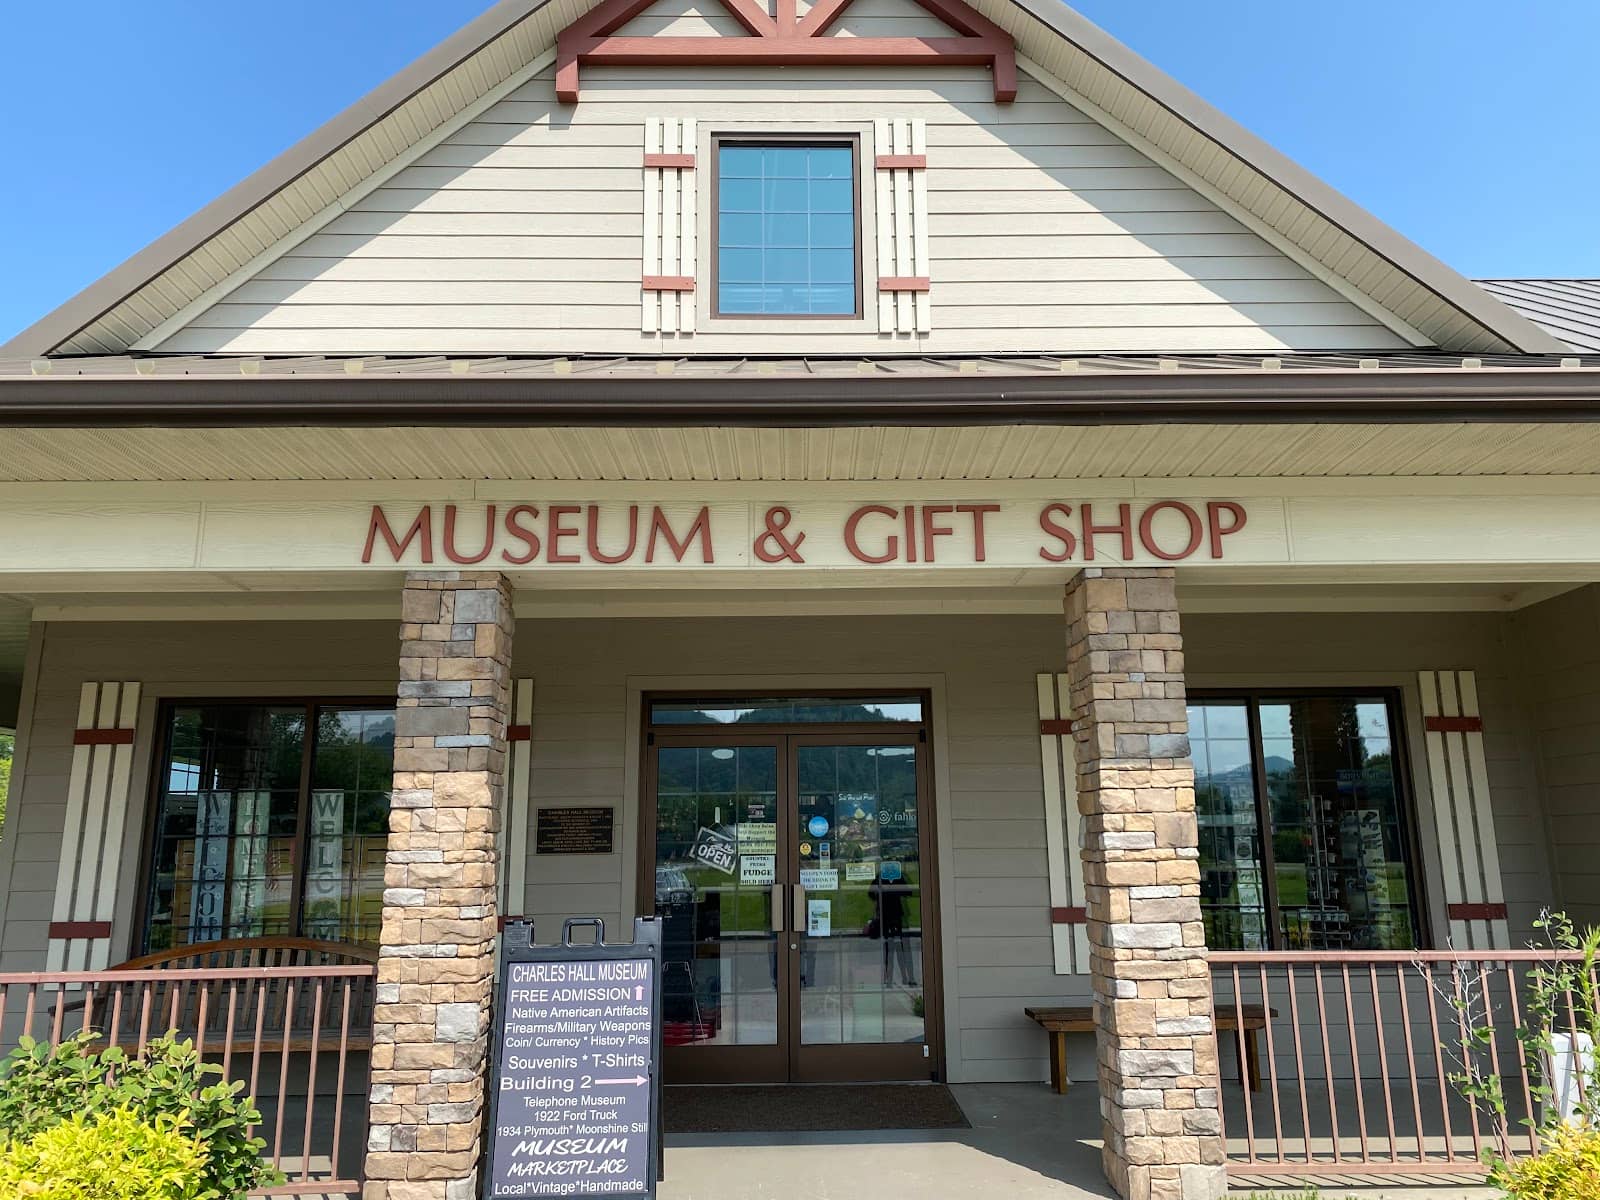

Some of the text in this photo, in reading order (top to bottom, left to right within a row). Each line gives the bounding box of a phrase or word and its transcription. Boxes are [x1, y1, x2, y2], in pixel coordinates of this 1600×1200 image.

[361, 500, 1248, 564] MUSEUM & GIFT SHOP
[698, 843, 732, 867] OPEN
[743, 869, 773, 877] FUDGE
[512, 963, 647, 983] CHARLES HALL MUSEUM
[510, 988, 631, 1003] FREE ADMISSION
[512, 1005, 649, 1019] Native American Artifacts
[504, 1021, 651, 1035] Firearms/Military Weapons
[505, 1035, 650, 1049] Coin/ Currency History Pics
[508, 1053, 645, 1070] Souvenirs T-Shirts
[500, 1075, 593, 1092] Building 2
[523, 1095, 626, 1108] Telephone Museum
[534, 1109, 618, 1122] 1922 Ford Truck
[497, 1126, 522, 1137] 1934
[575, 1123, 628, 1135] Moonshine
[631, 1122, 648, 1134] Still
[511, 1137, 628, 1156] MUSEUM
[506, 1158, 629, 1177] MARKETPLACE
